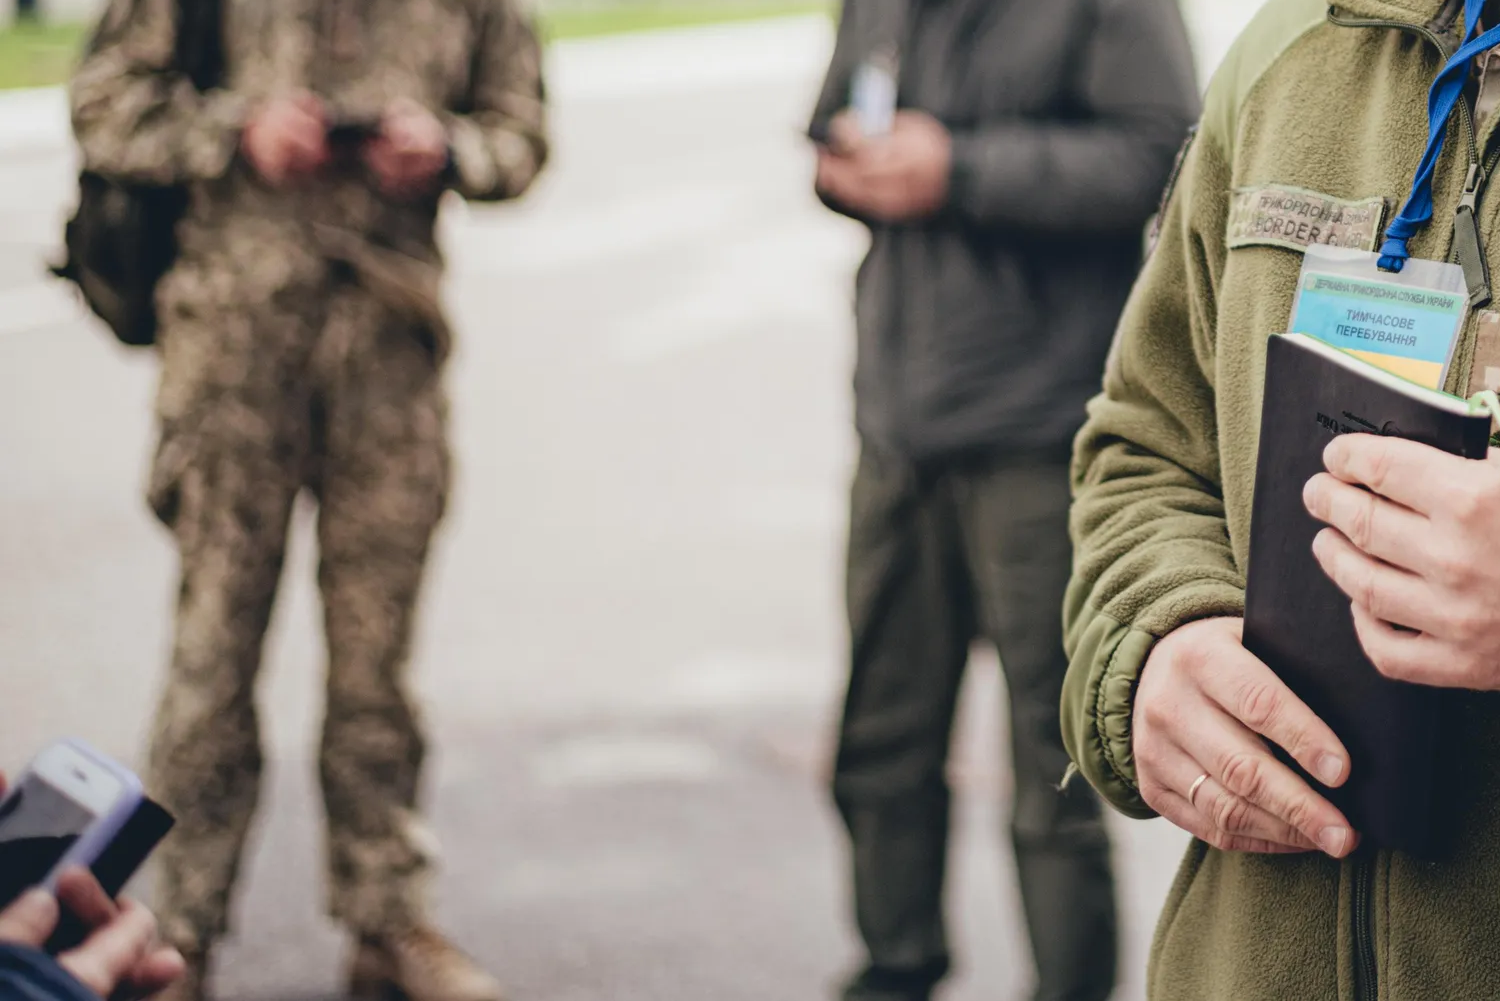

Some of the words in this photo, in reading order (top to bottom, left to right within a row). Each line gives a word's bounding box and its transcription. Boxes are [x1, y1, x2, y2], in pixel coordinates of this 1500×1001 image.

[1255, 217, 1321, 244] BORDER
[1346, 309, 1416, 330] ТИМЧАСОВЕ
[1336, 324, 1417, 347] ПЕРЕБУВАННЯ
